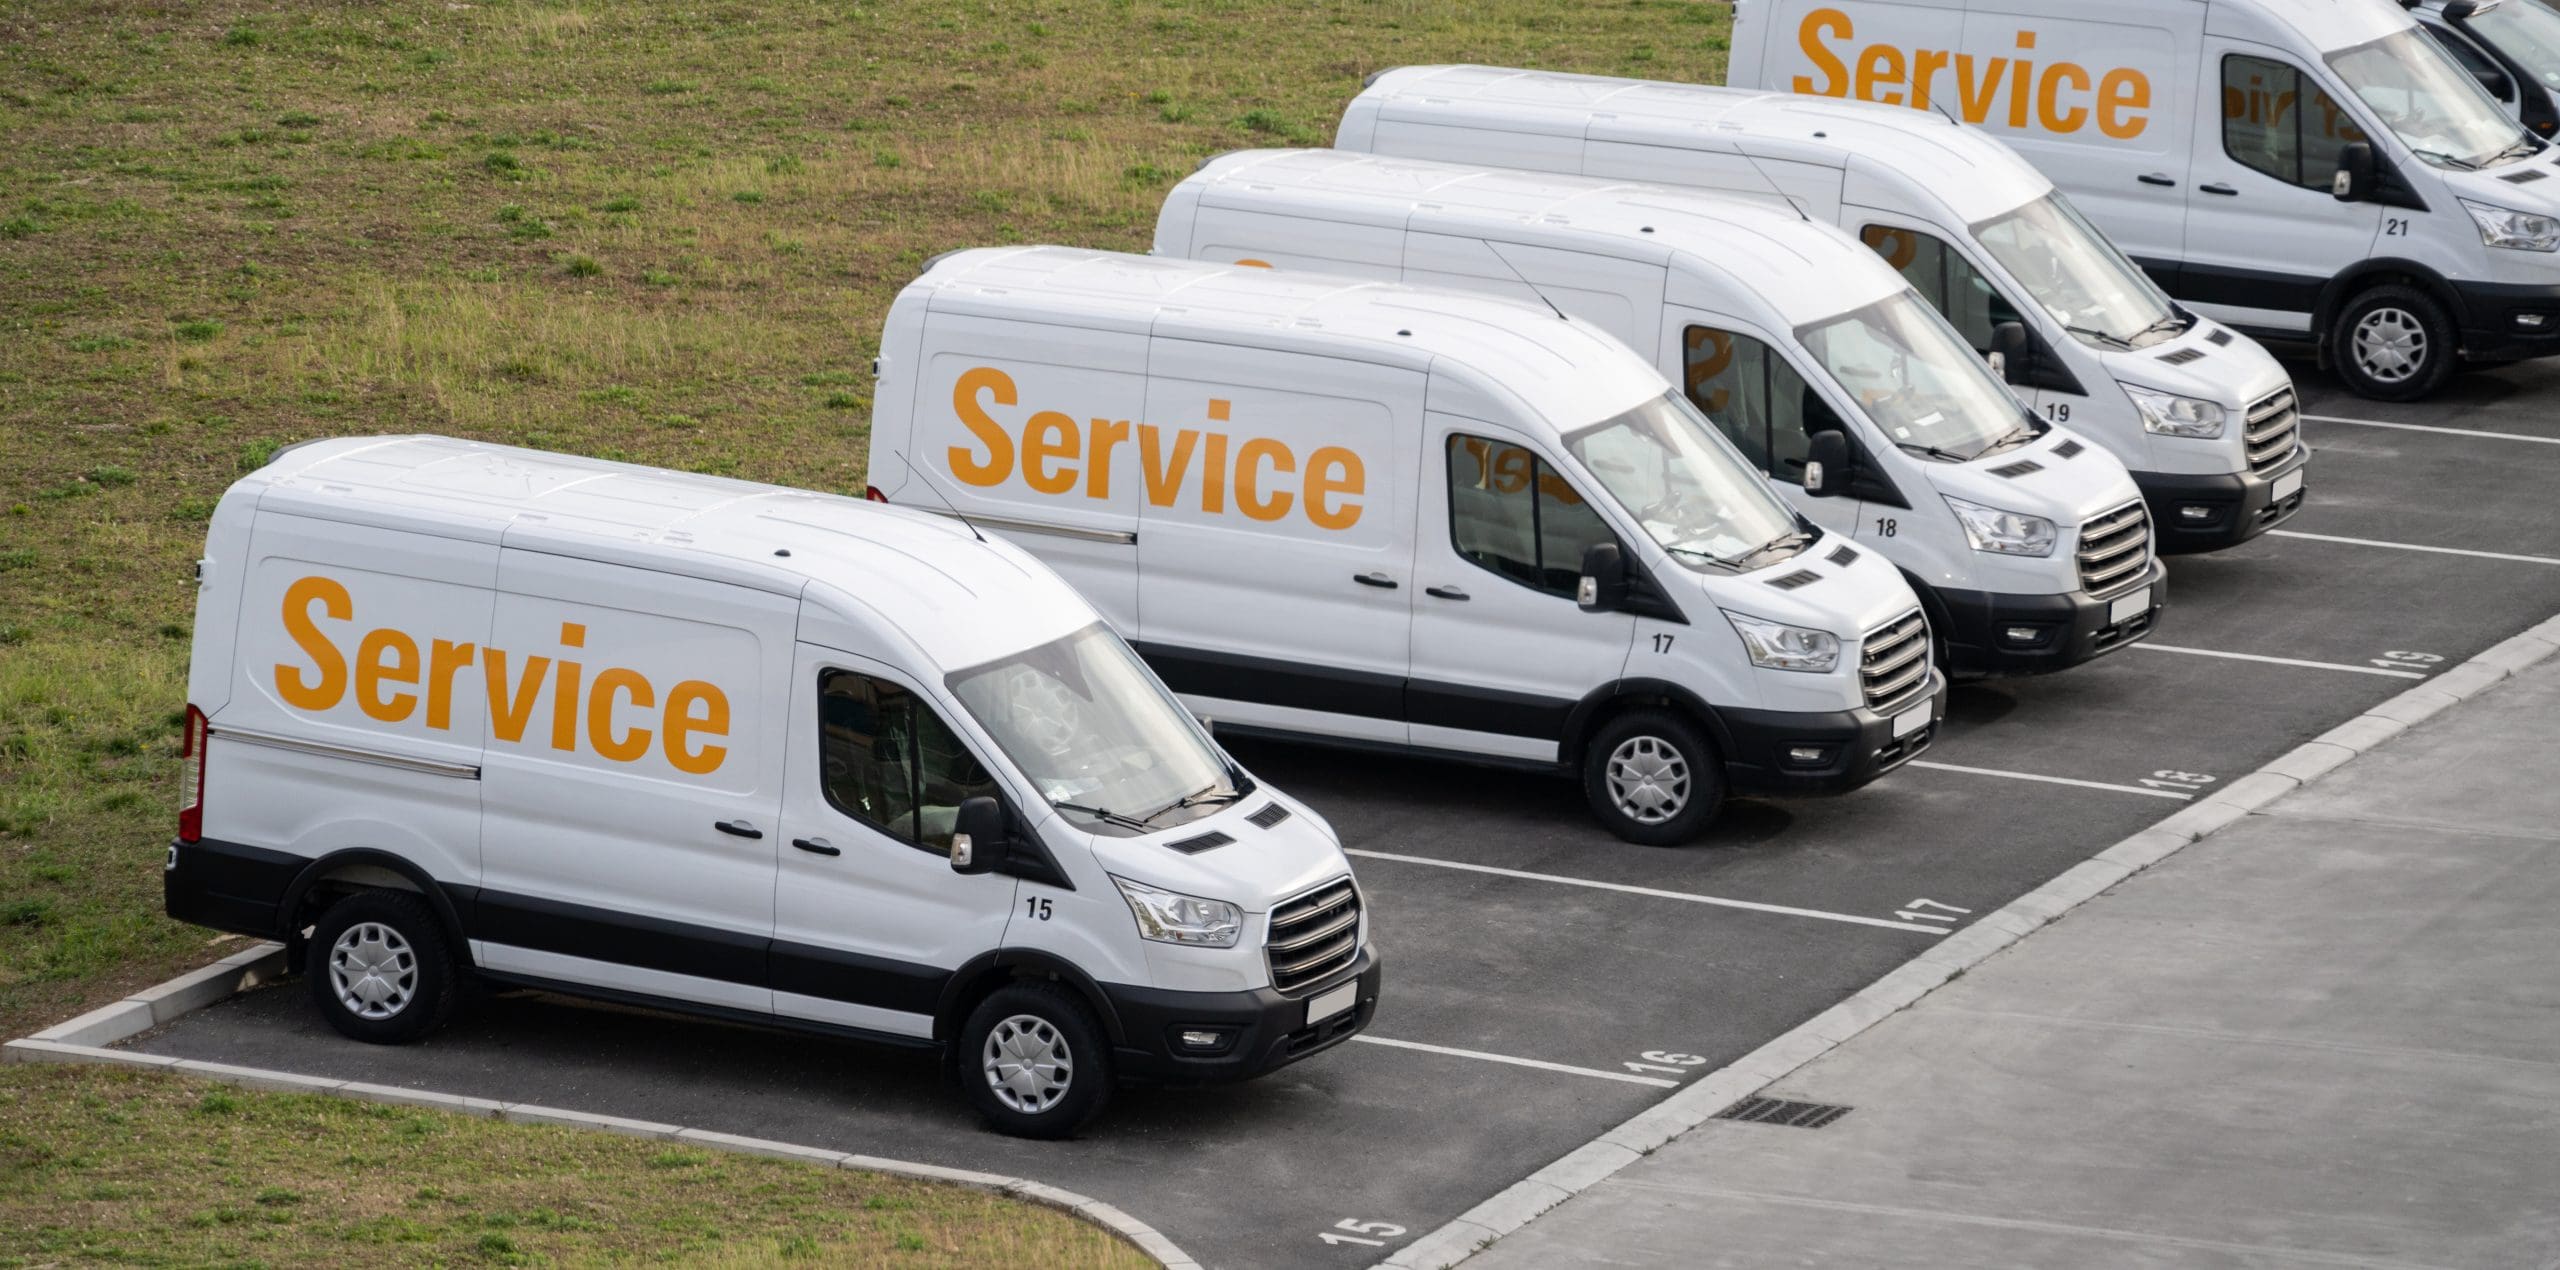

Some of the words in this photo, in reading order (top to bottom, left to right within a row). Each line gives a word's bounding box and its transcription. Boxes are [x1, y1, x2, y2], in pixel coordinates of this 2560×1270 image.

[1792, 8, 2151, 140] Service
[2386, 218, 2409, 237] 21
[2046, 402, 2070, 424] 19
[947, 367, 1365, 530] Service
[1876, 517, 1897, 538] 18
[1652, 632, 1675, 654] 17
[2369, 650, 2445, 670] 19
[274, 576, 731, 775] Service
[2138, 769, 2217, 790] 18
[1026, 895, 1053, 922] 15
[1894, 898, 1972, 922] 17
[1622, 1050, 1708, 1075] 16
[1317, 1217, 1407, 1247] 15
